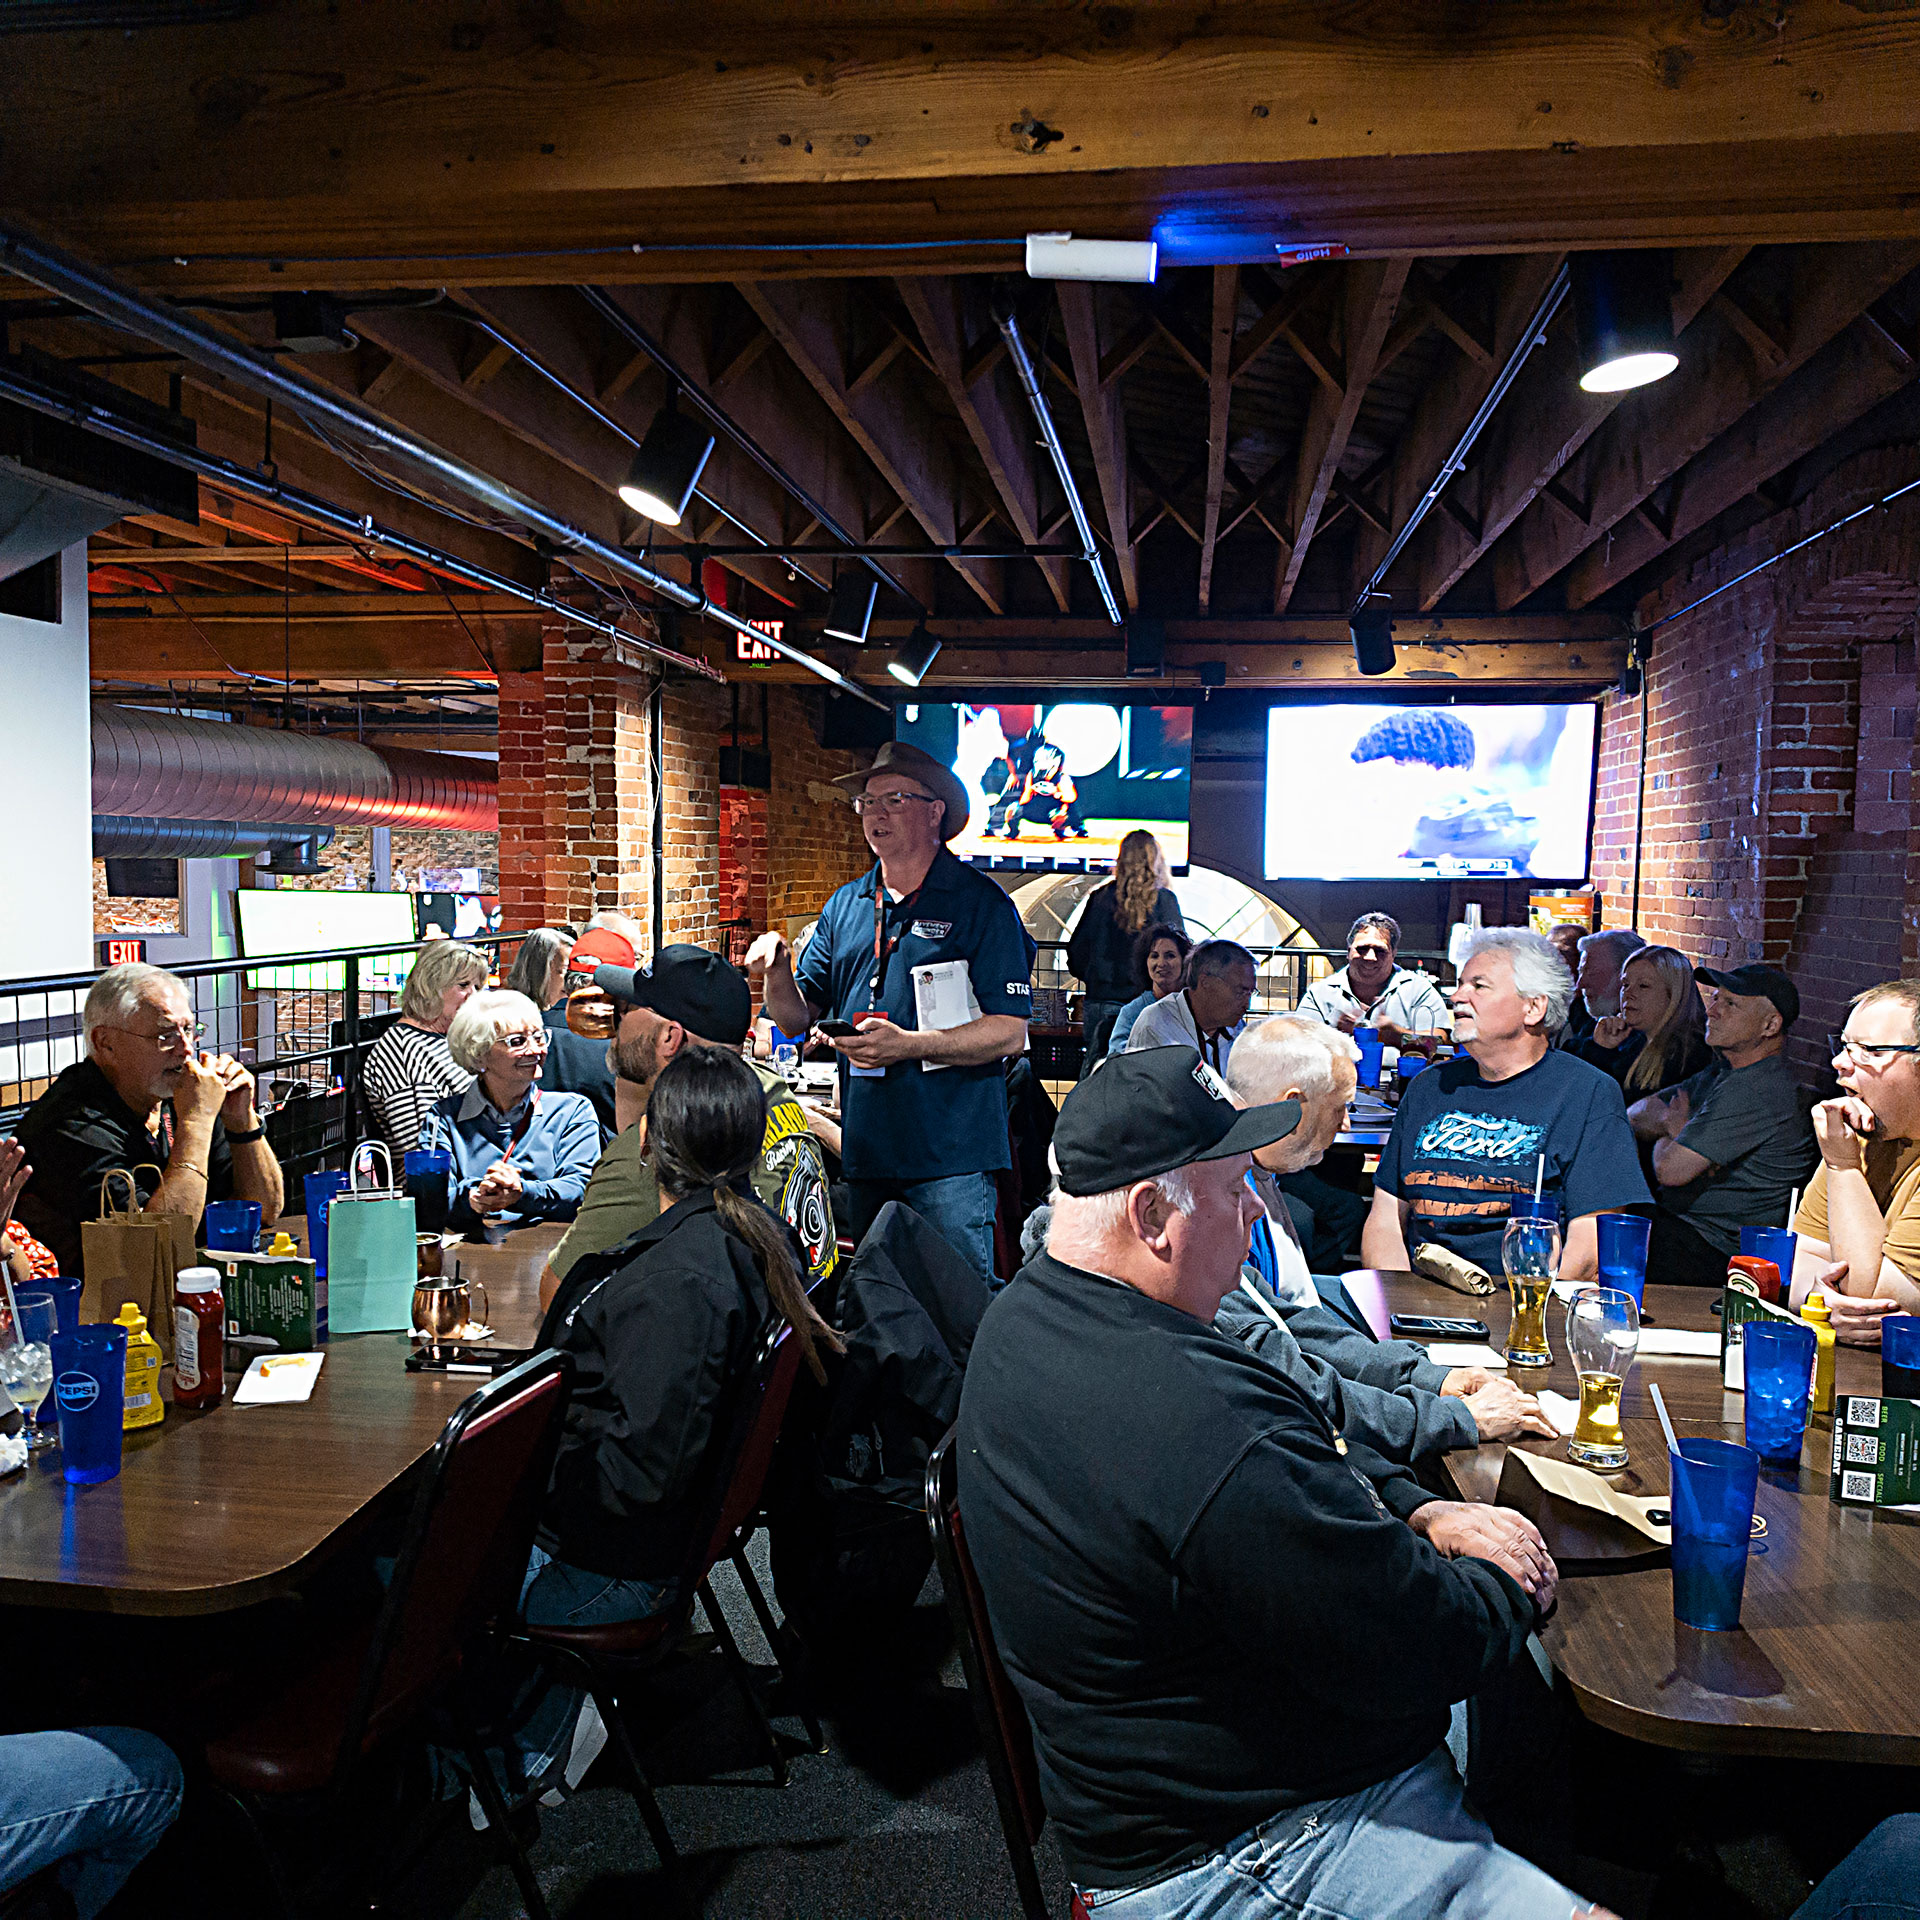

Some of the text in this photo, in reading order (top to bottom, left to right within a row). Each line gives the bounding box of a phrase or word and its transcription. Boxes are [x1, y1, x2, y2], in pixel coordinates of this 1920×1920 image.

[737, 620, 784, 659] EXIT
[109, 940, 141, 964] EXIT
[1422, 1114, 1527, 1159] Ford
[765, 1138, 797, 1171] Racing
[59, 1386, 96, 1396] PEPSI
[1833, 1418, 1843, 1475] GAMEDAY
[1878, 1442, 1886, 1462] FOOD
